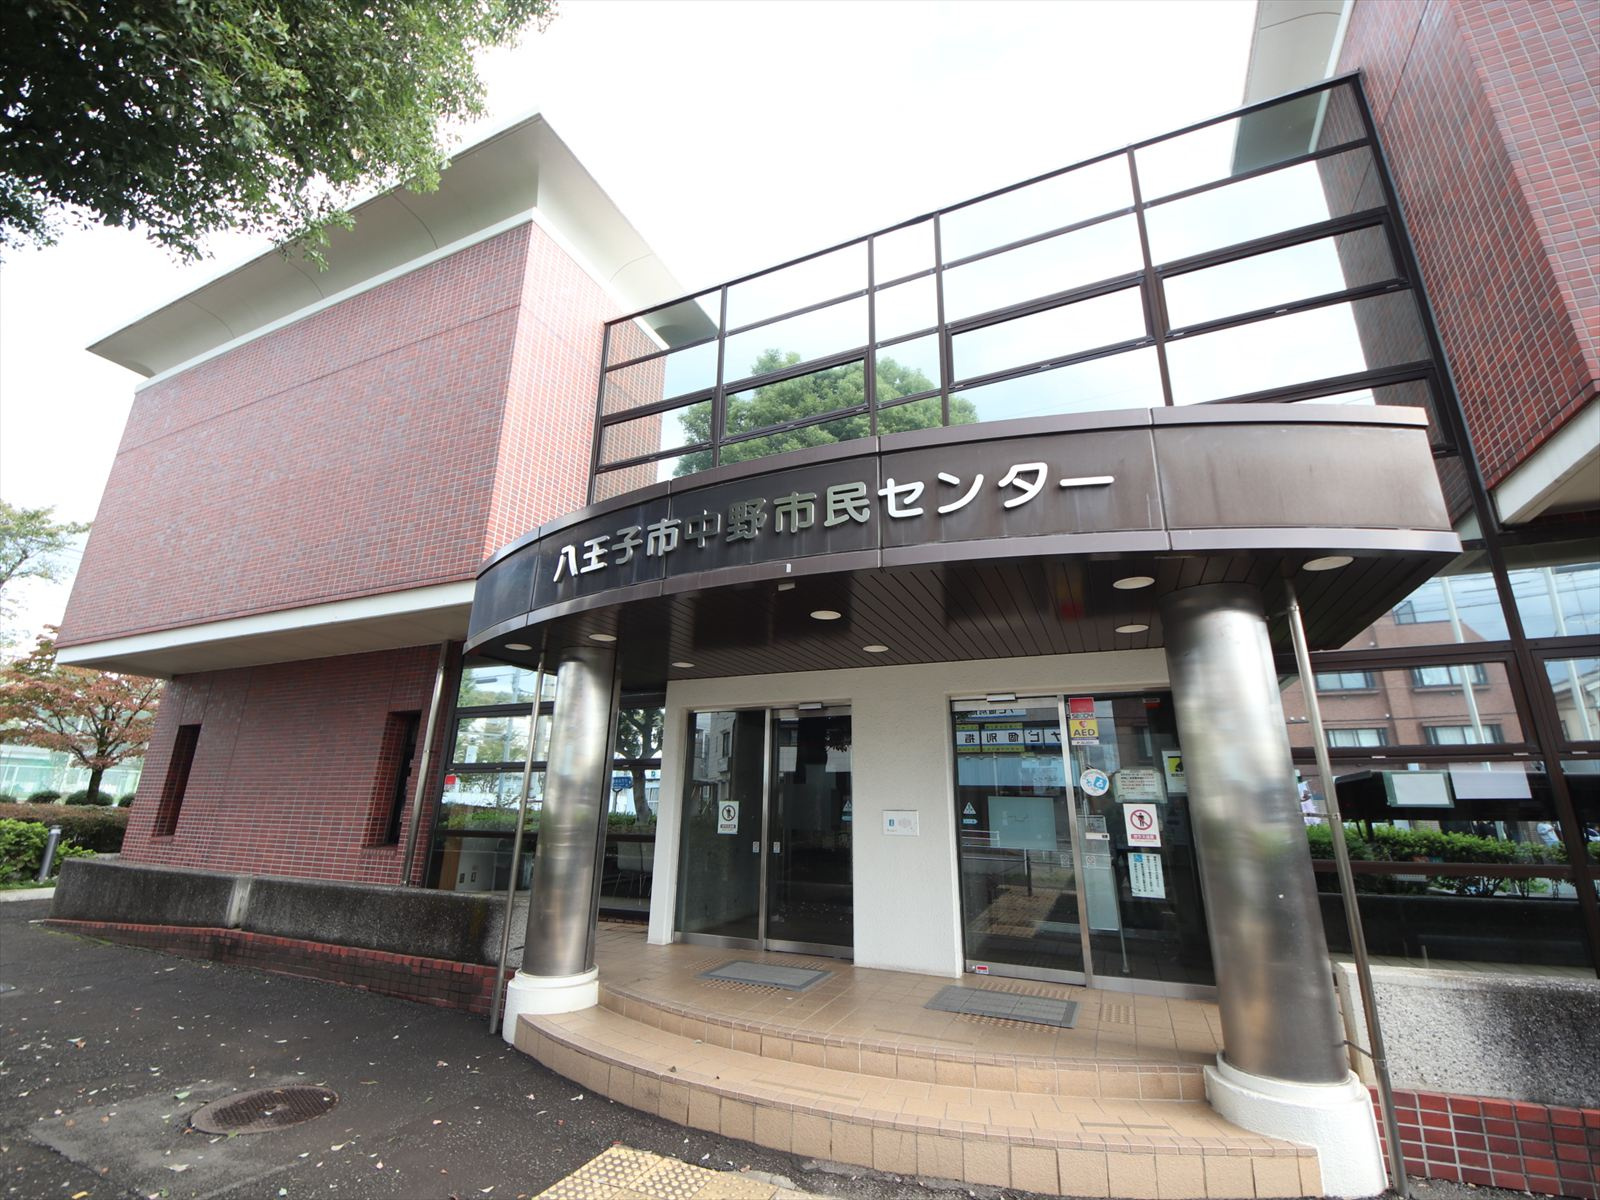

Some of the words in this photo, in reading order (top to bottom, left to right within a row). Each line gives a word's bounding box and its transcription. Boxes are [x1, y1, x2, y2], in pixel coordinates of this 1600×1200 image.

[553, 462, 1115, 583] 八王子市中野市民センター
